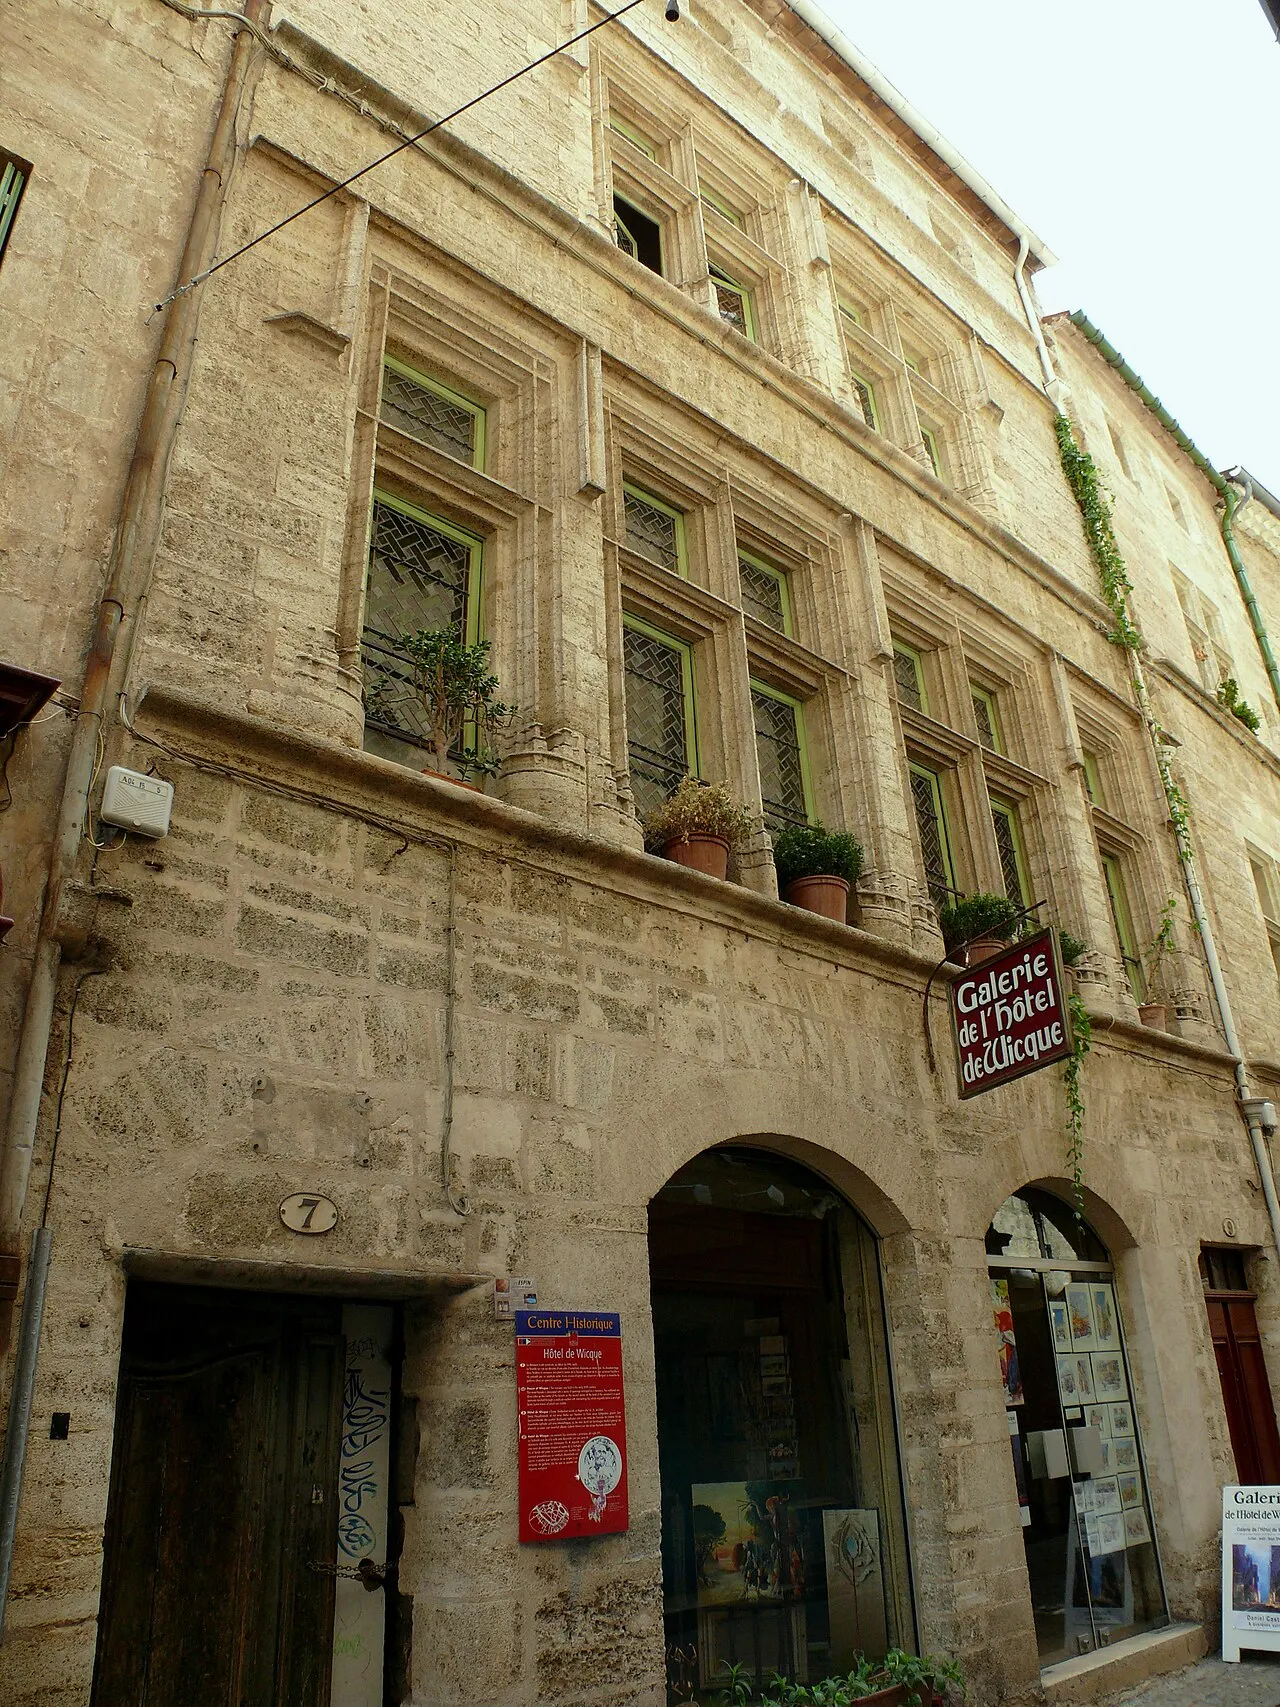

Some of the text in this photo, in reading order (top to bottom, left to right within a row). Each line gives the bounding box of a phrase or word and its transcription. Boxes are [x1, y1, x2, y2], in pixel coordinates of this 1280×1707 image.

[957, 953, 1049, 1014] Galerie
[959, 1019, 979, 1048] de
[298, 1198, 321, 1229] 7
[527, 1315, 614, 1332] Centre Historique
[543, 1348, 603, 1361] Hôtel de Wicque
[1225, 1510, 1236, 1520] de
[1261, 1510, 1272, 1520] de
